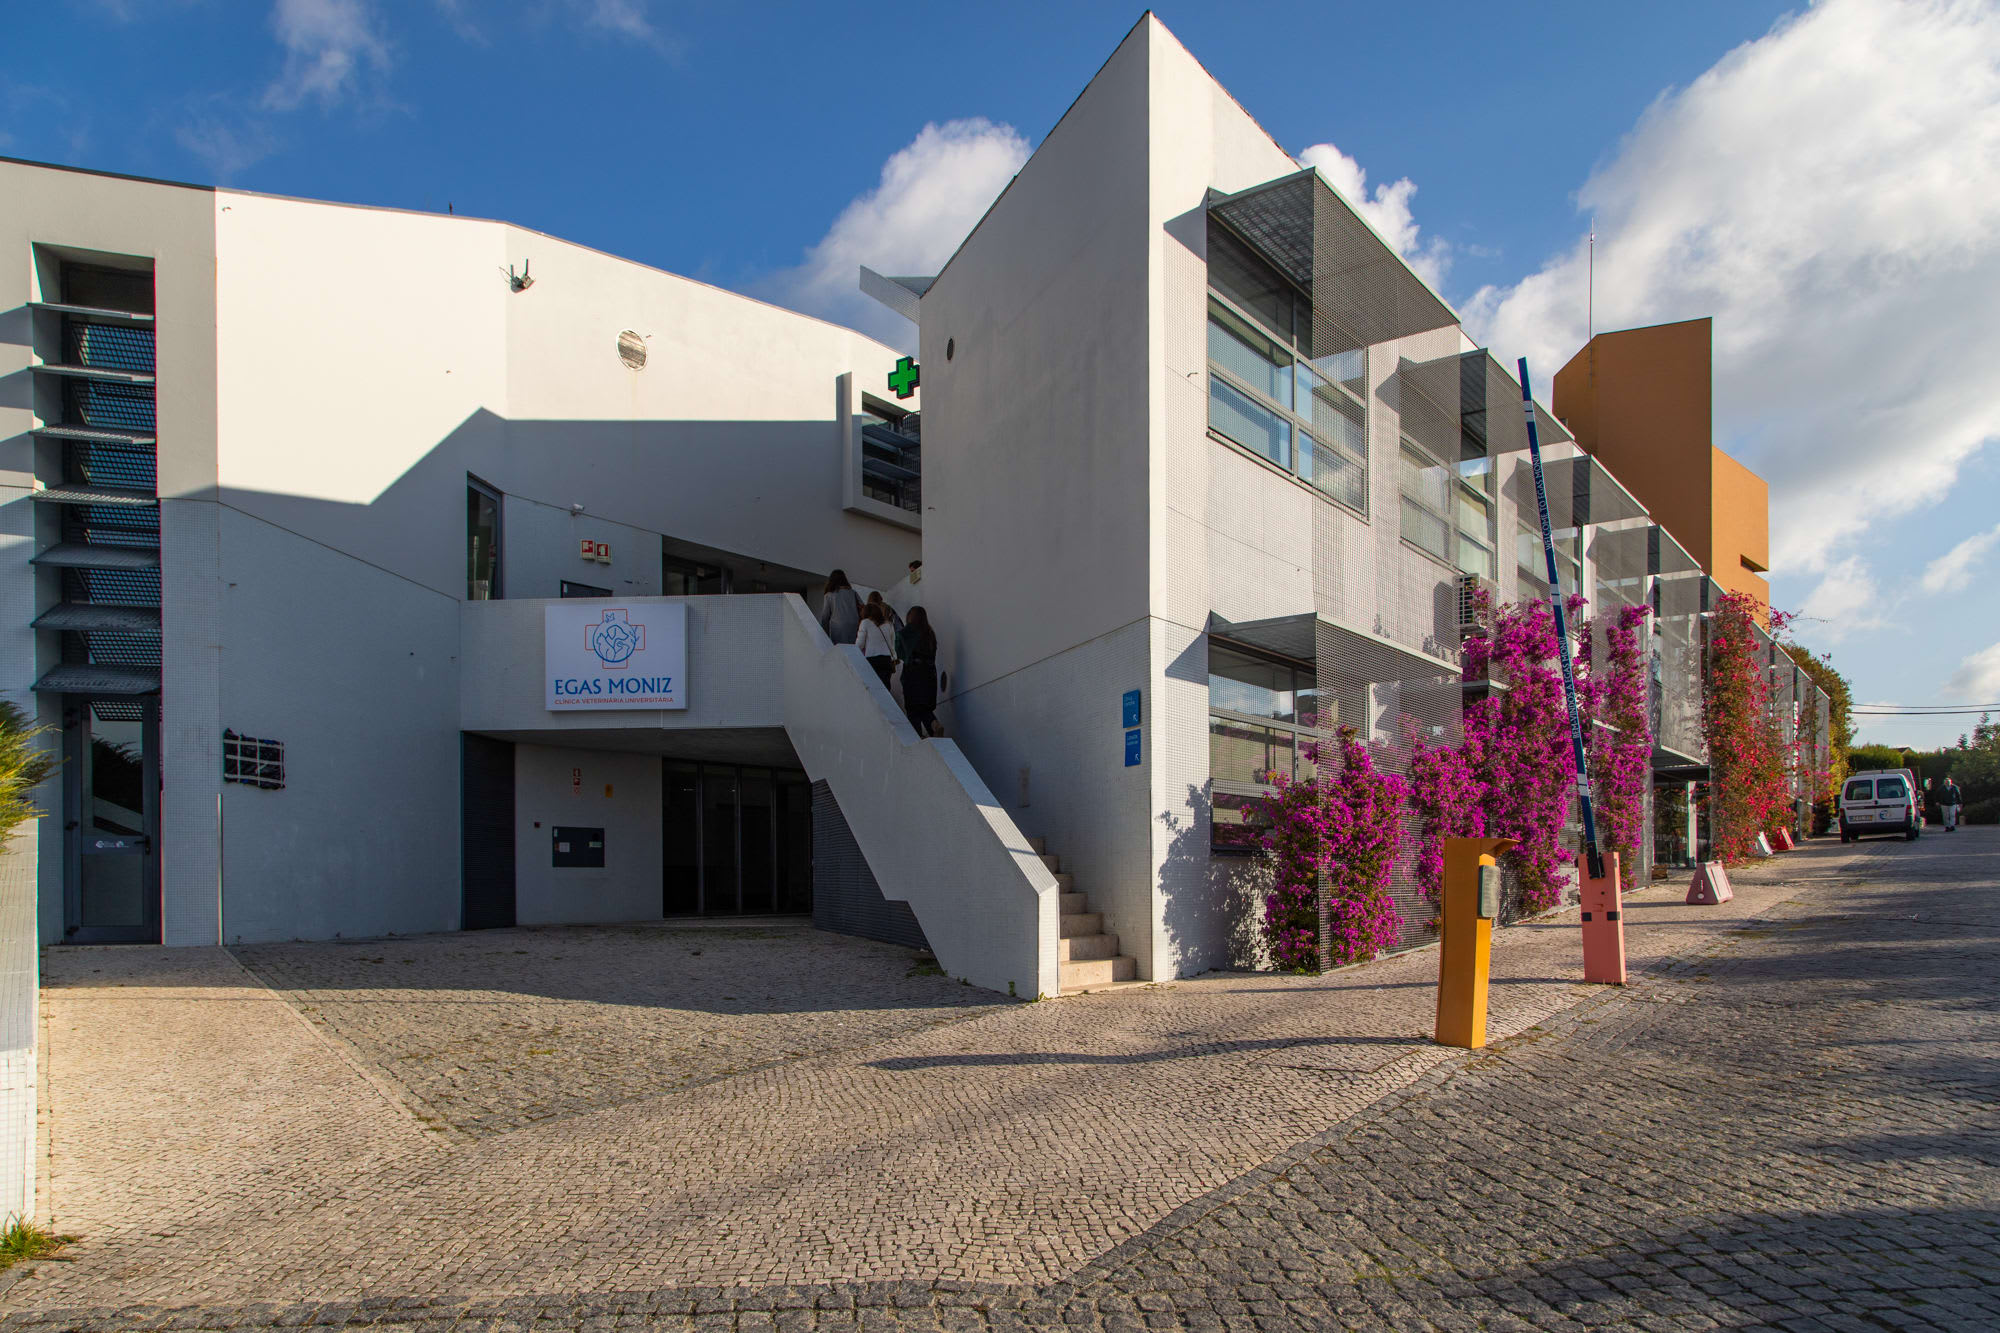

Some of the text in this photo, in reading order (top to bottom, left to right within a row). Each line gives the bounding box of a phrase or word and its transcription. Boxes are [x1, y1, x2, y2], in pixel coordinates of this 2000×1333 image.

[1532, 452, 1552, 551] WELCOME TO EGAS MONIZ
[1558, 636, 1569, 662] MONIZ
[1562, 663, 1573, 684] EGAS
[555, 677, 673, 695] EGAS MONIZ
[554, 697, 581, 705] CLÍNICA
[582, 696, 624, 704] VETERINÁRIA
[1567, 692, 1580, 739] BEM-VINDOS
